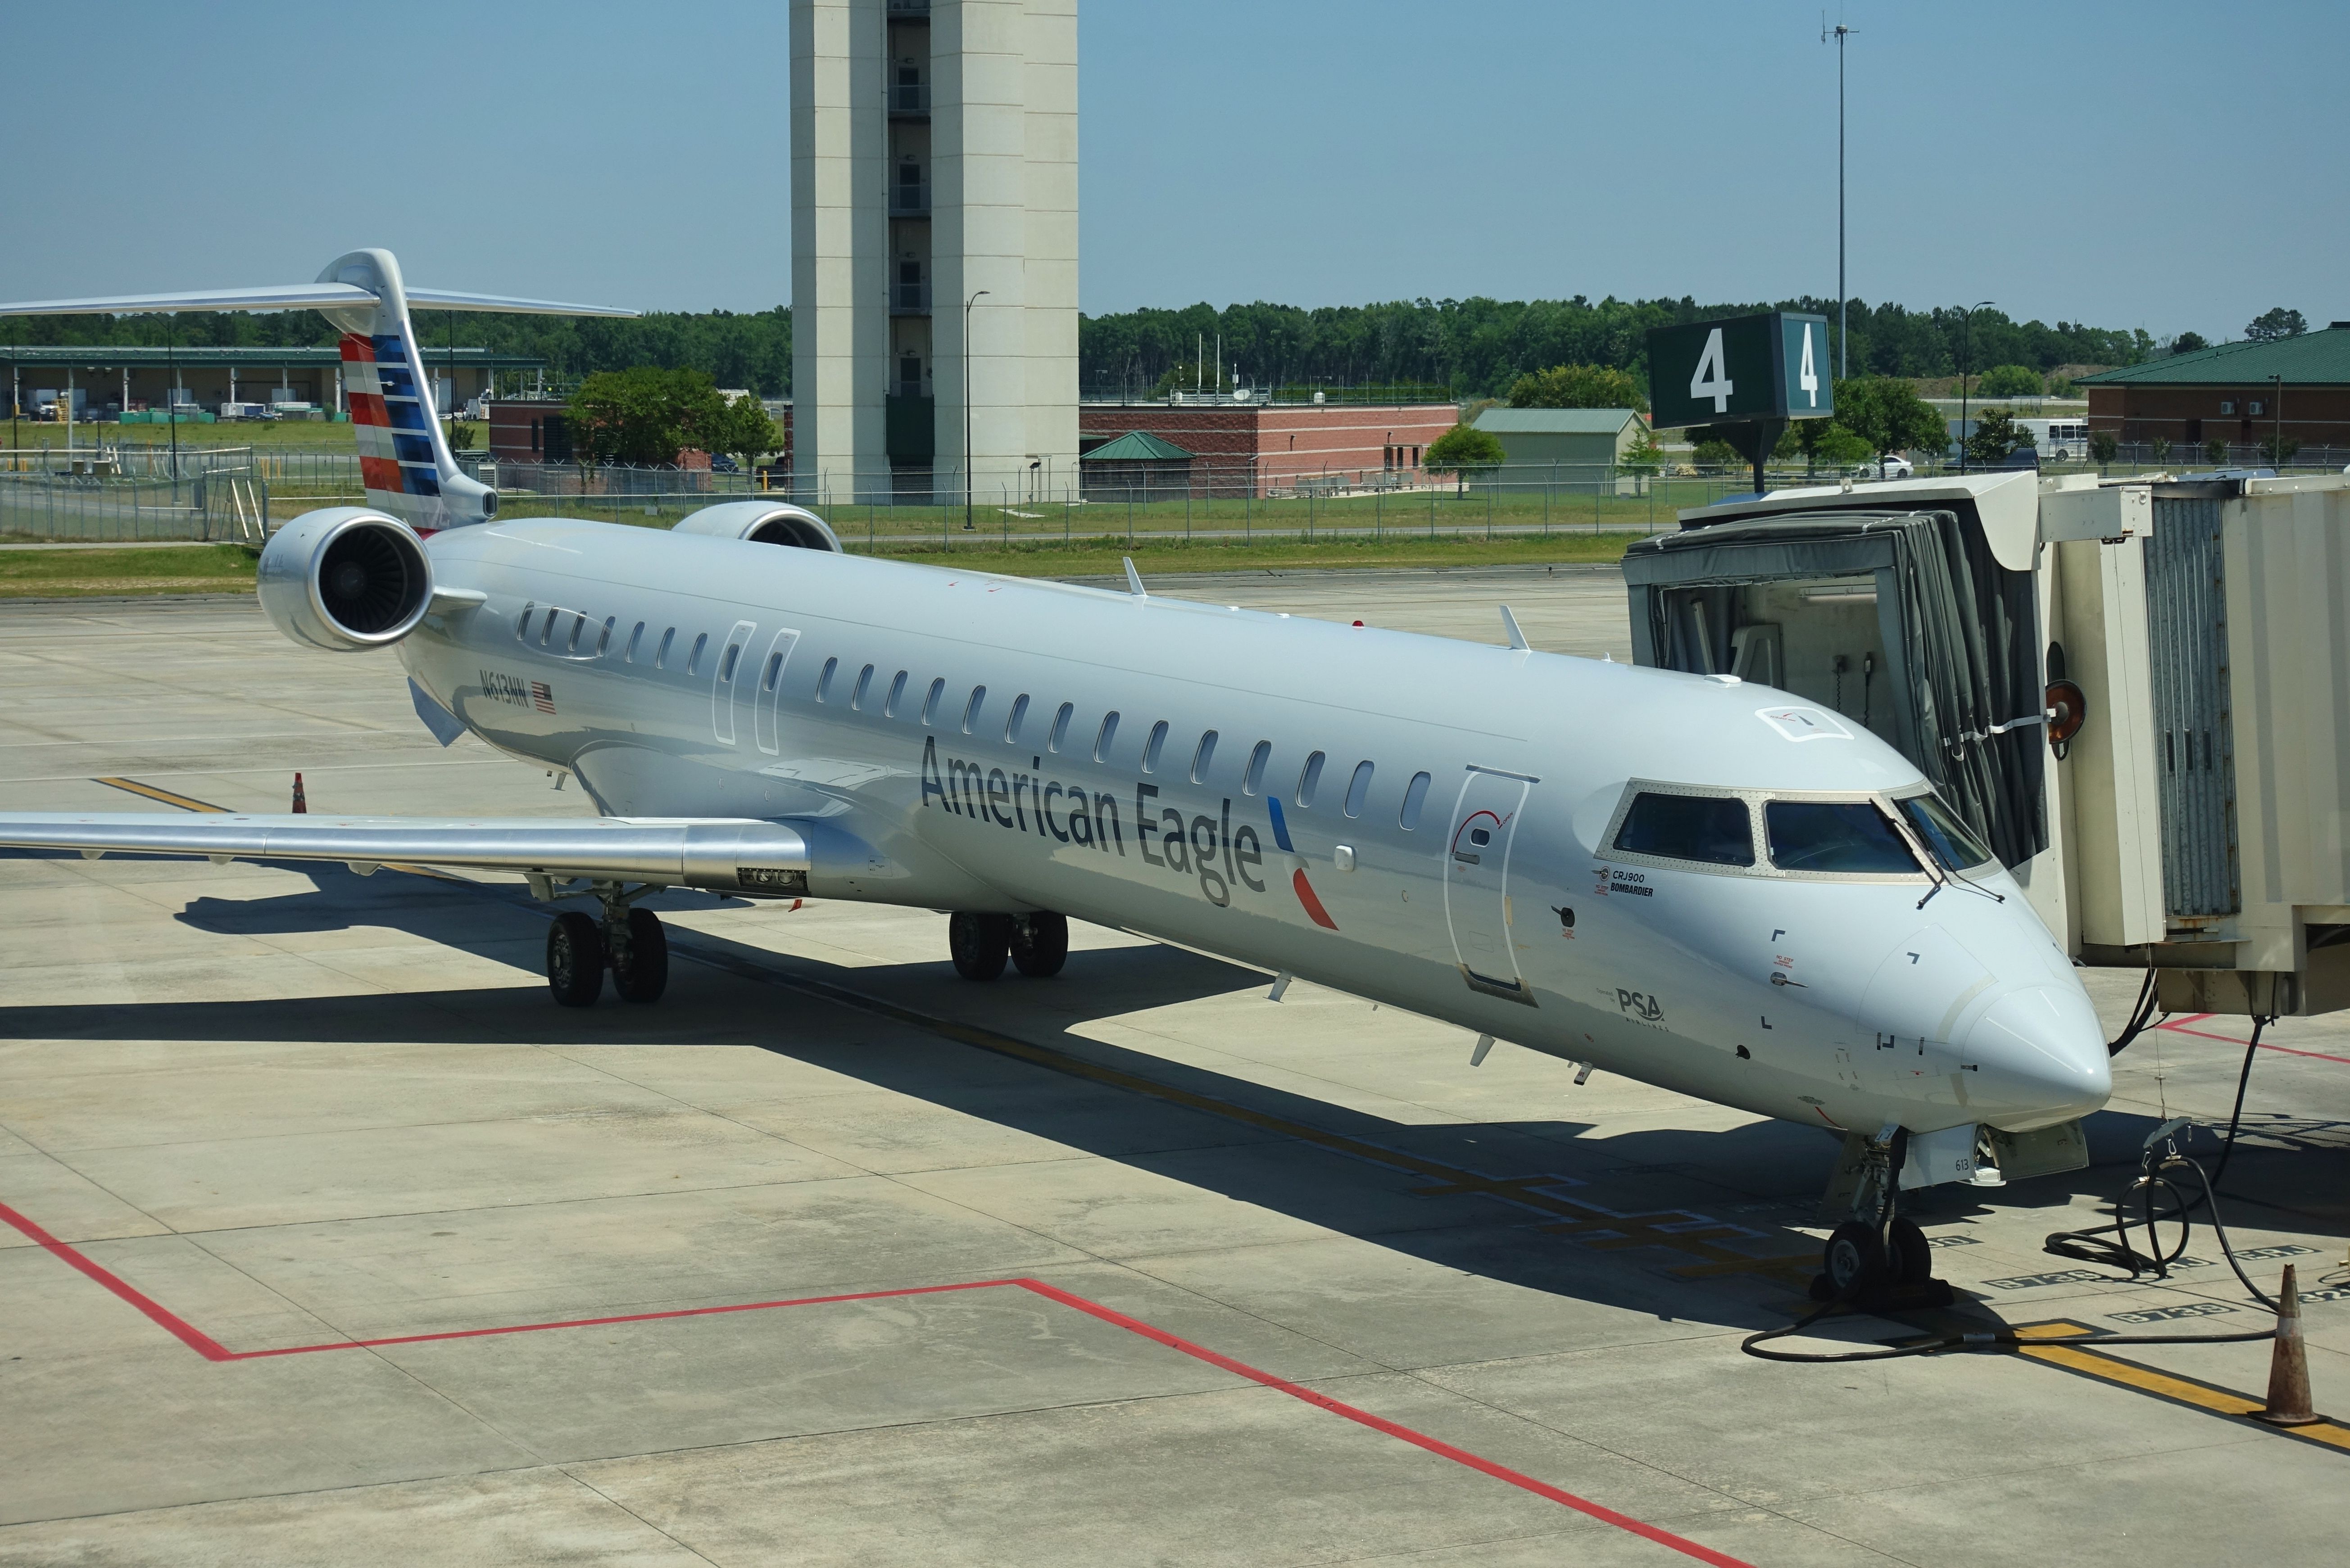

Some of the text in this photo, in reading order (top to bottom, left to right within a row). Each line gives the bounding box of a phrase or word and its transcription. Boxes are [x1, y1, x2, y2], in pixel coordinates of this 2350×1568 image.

[1690, 328, 1733, 413] 4
[1801, 323, 1818, 407] 4
[480, 669, 529, 708] N613NN
[921, 735, 1266, 908] American Eagle
[1503, 811, 1513, 824] OPEN
[1613, 870, 1644, 883] CRJ900
[1611, 882, 1653, 897] BOMBARDIER
[1615, 988, 1661, 1017] PSA
[1626, 1017, 1669, 1032] AIRLINES
[1955, 1159, 1969, 1171] 613
[1988, 1269, 2103, 1289] B738
[2112, 1304, 2230, 1323] B739
